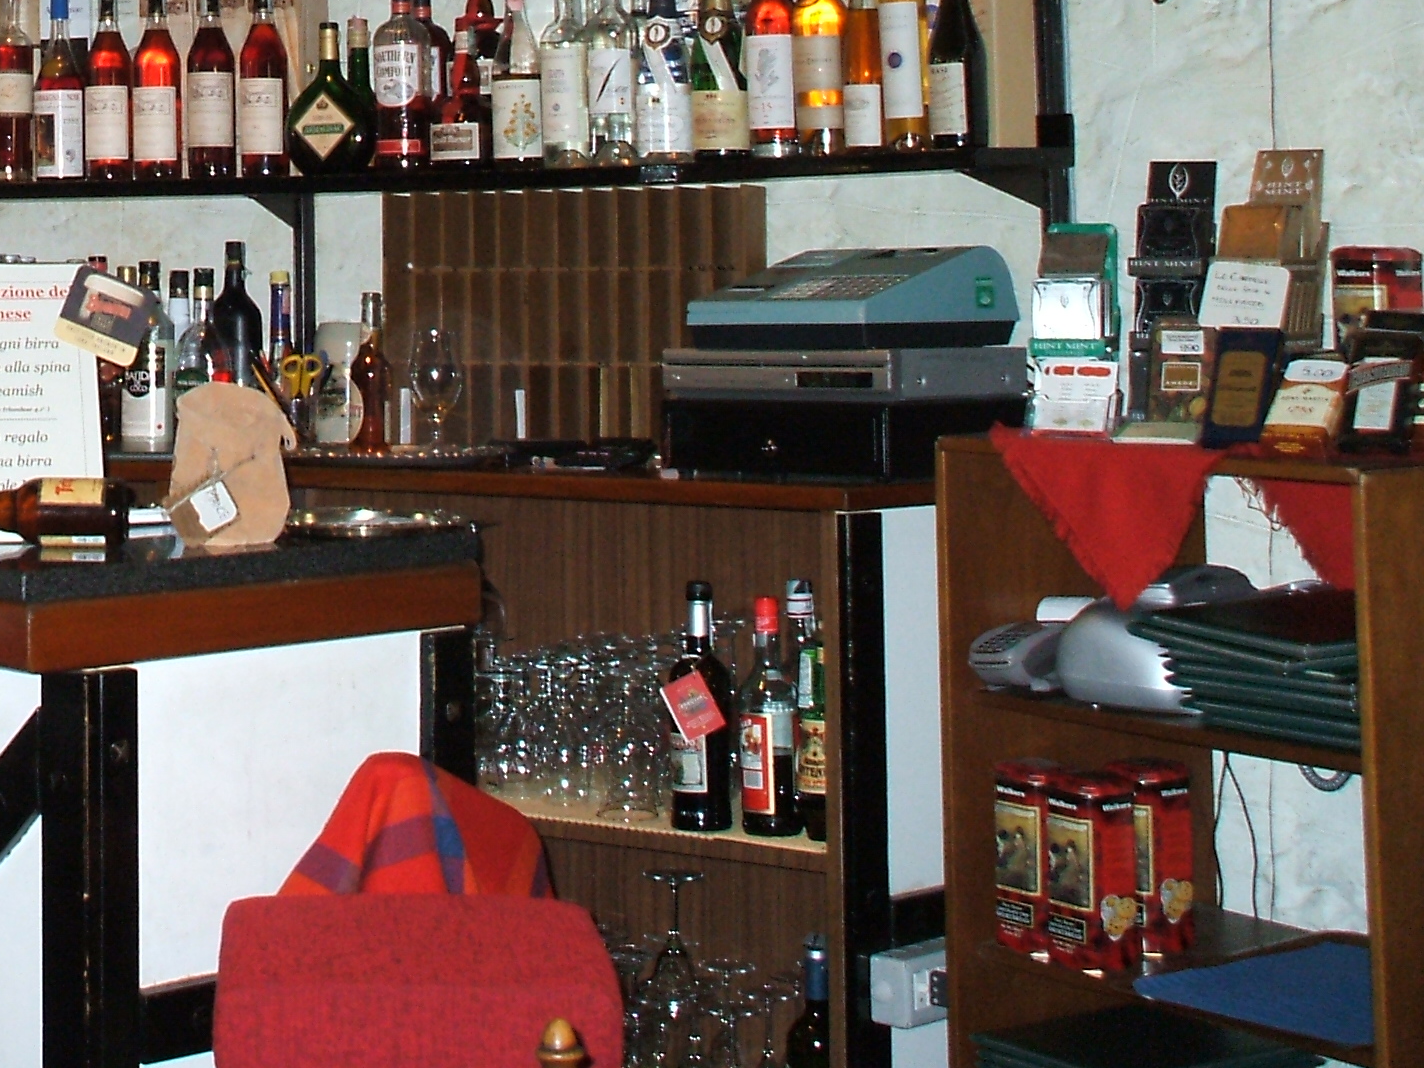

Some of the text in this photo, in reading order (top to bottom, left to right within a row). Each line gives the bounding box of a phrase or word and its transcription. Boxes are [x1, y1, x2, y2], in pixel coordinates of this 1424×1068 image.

[24, 337, 60, 350] birra
[4, 360, 34, 373] alla
[33, 361, 71, 376] spina
[4, 430, 48, 446] regalo
[16, 454, 52, 467] birra
